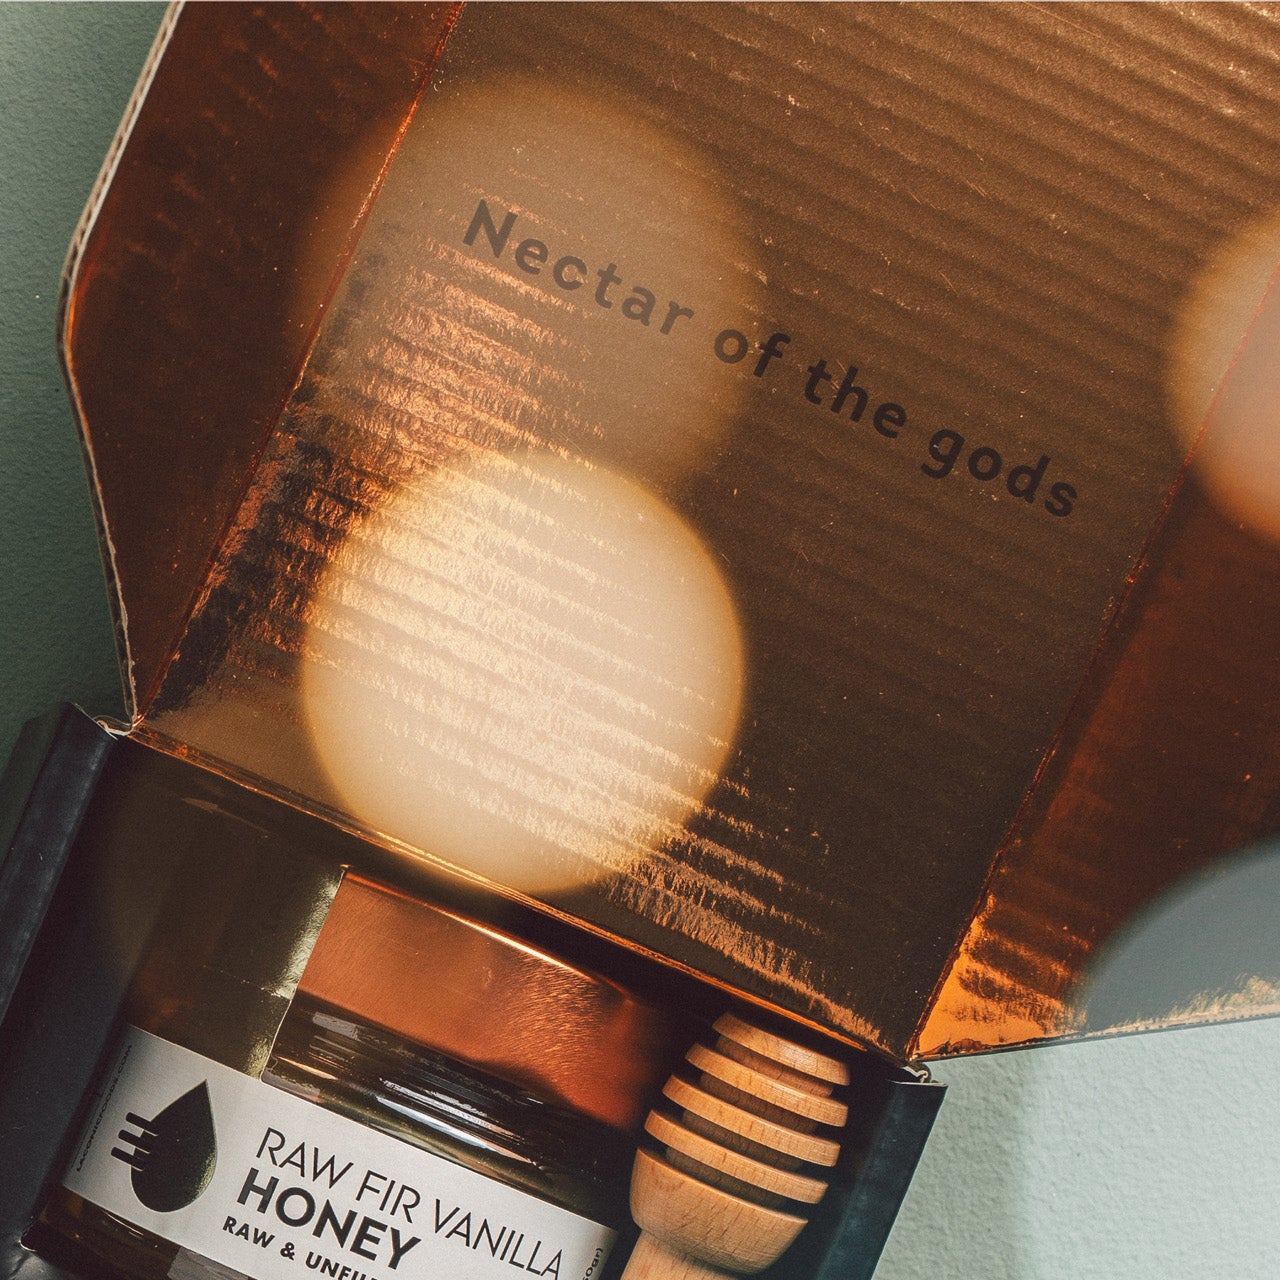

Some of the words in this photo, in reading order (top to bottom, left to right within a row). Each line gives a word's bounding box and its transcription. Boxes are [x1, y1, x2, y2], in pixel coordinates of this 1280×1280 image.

[462, 200, 694, 336] Nectar
[713, 327, 791, 378] of
[802, 358, 907, 439] the
[922, 429, 1078, 518] gods
[237, 1167, 422, 1270] HONEY
[256, 1127, 353, 1188] RAW
[357, 1169, 421, 1224] FIR
[222, 1216, 276, 1249] RAW
[280, 1242, 296, 1260] &
